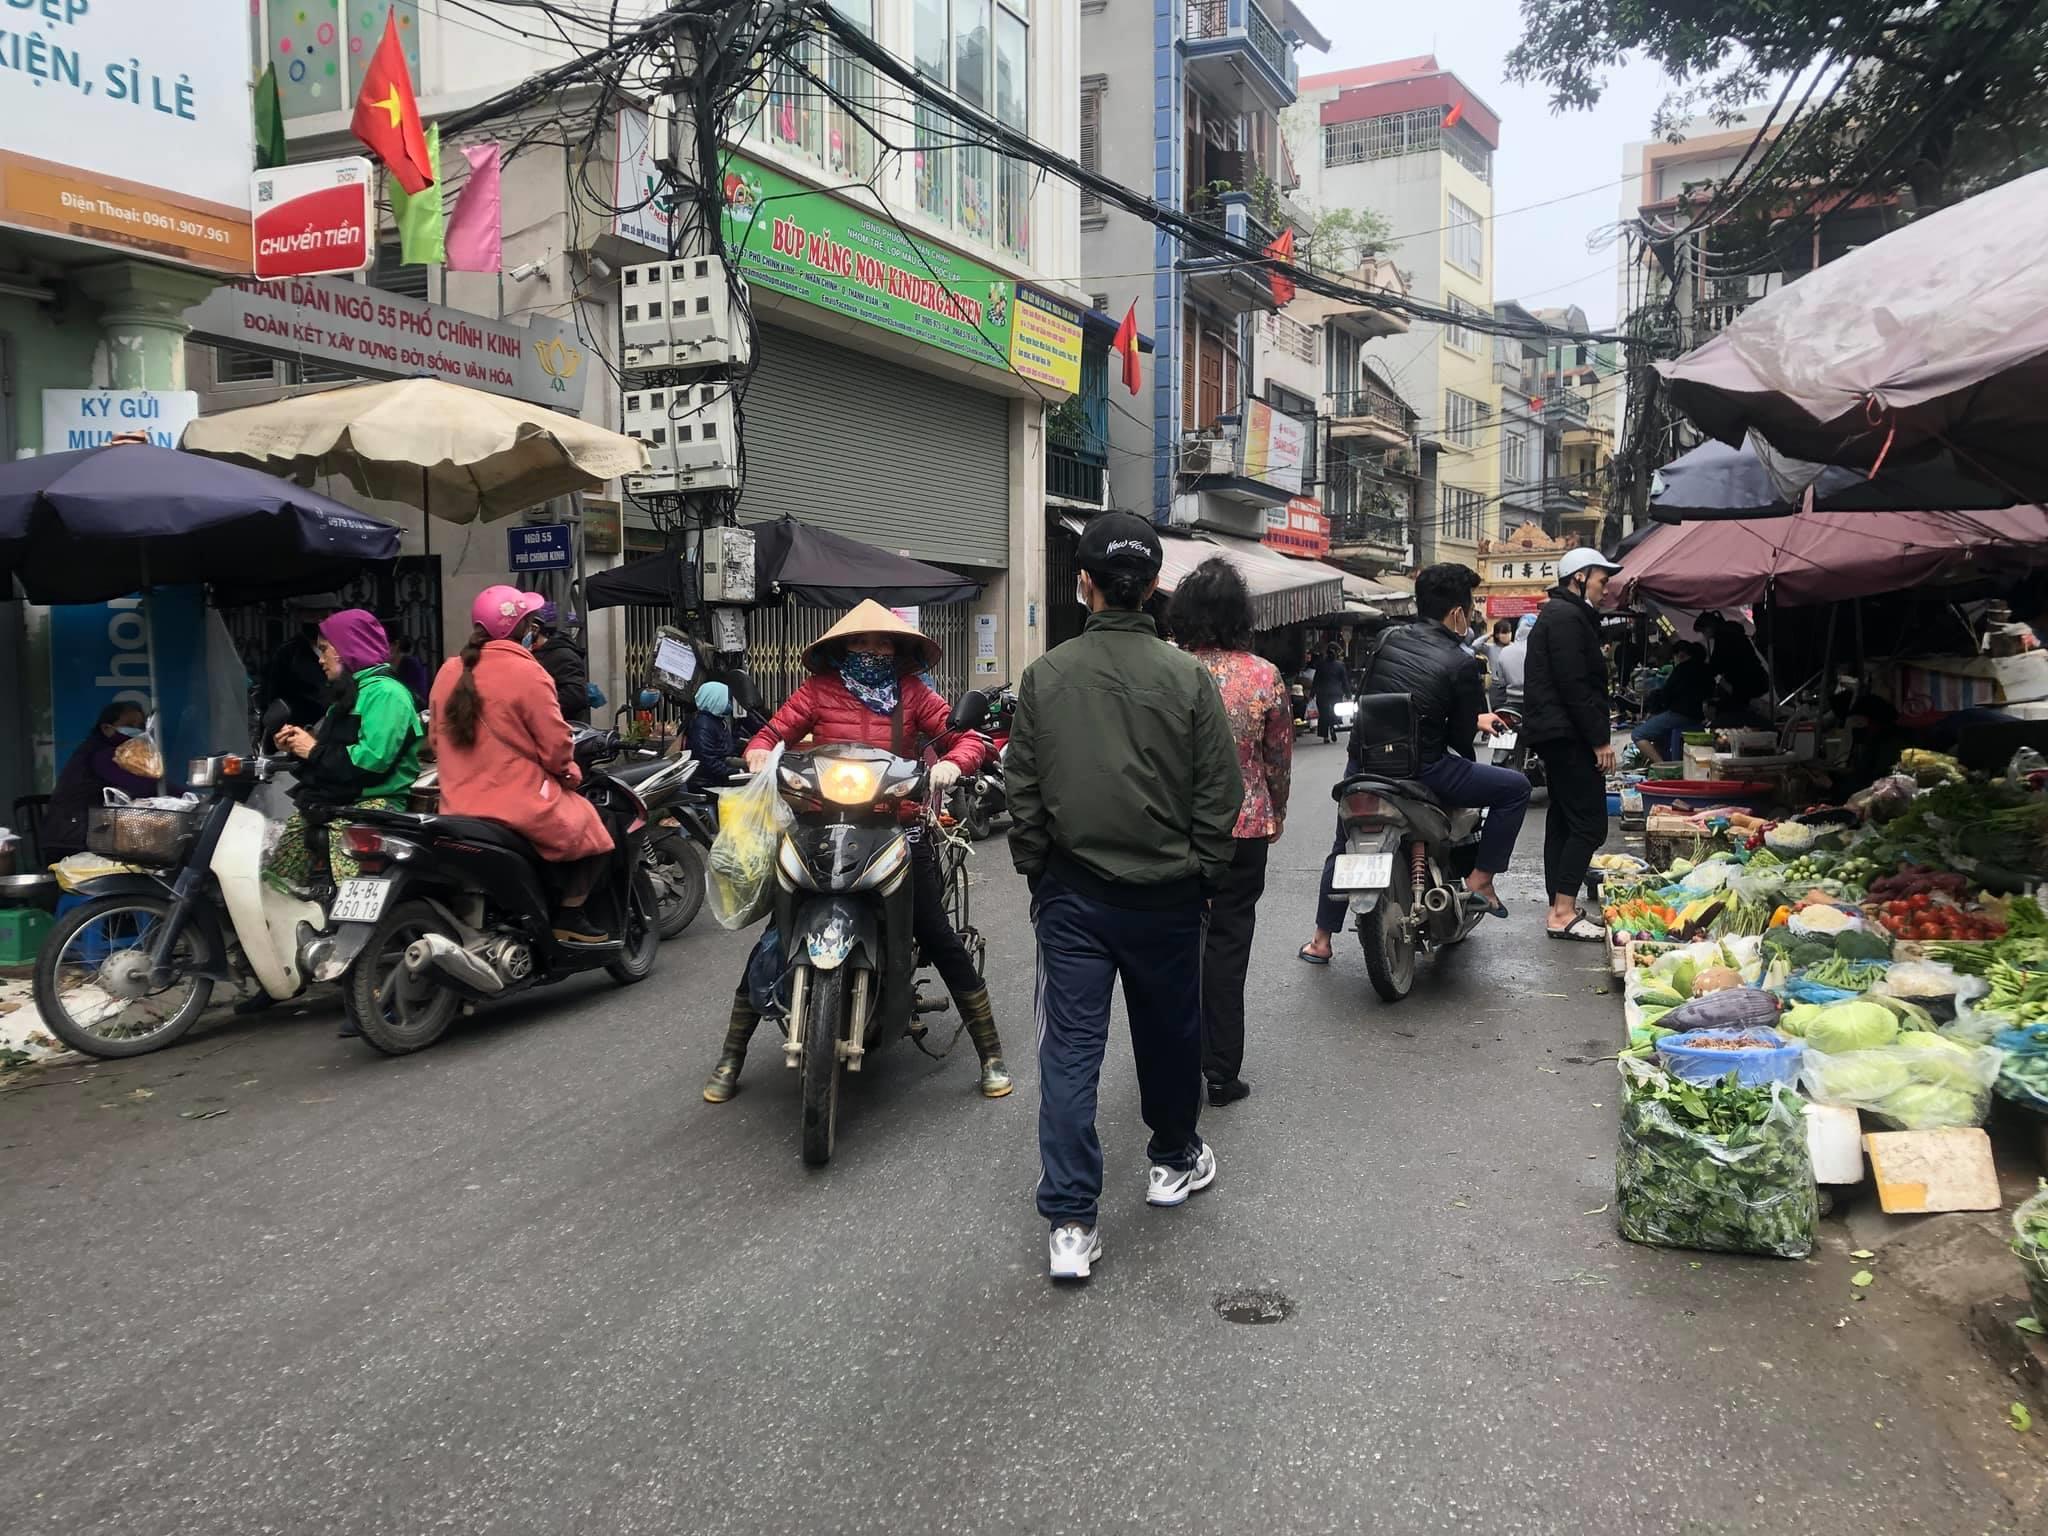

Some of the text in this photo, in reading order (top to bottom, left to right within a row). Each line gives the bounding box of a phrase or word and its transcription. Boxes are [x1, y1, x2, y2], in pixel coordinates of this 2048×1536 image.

[105, 58, 140, 105] SỈ
[152, 73, 196, 121] LẺ
[60, 191, 230, 244] Điện Thoại: 0961.907.961
[772, 214, 806, 259] BÚP
[807, 228, 853, 278] MĂNG
[856, 251, 886, 292] NON
[886, 264, 983, 328] KINDERGARTEN
[291, 280, 330, 313] DÂN
[334, 293, 374, 323] NGÕ
[378, 304, 397, 328] 55
[399, 307, 433, 337] PHỐ
[437, 319, 483, 350] CHÍNH
[487, 331, 521, 359] KINH
[243, 311, 289, 338] ĐOÀN
[293, 321, 323, 345] KẾT
[327, 331, 355, 352] XÂY
[359, 339, 398, 361] DỰNG
[400, 346, 425, 367] ĐỜI
[427, 350, 461, 375] SỐNG
[81, 391, 160, 419] KÝ GỬI
[541, 531, 552, 543] 55
[549, 550, 565, 561] KINH
[1105, 539, 1128, 555] New
[333, 900, 379, 919] 260.18
